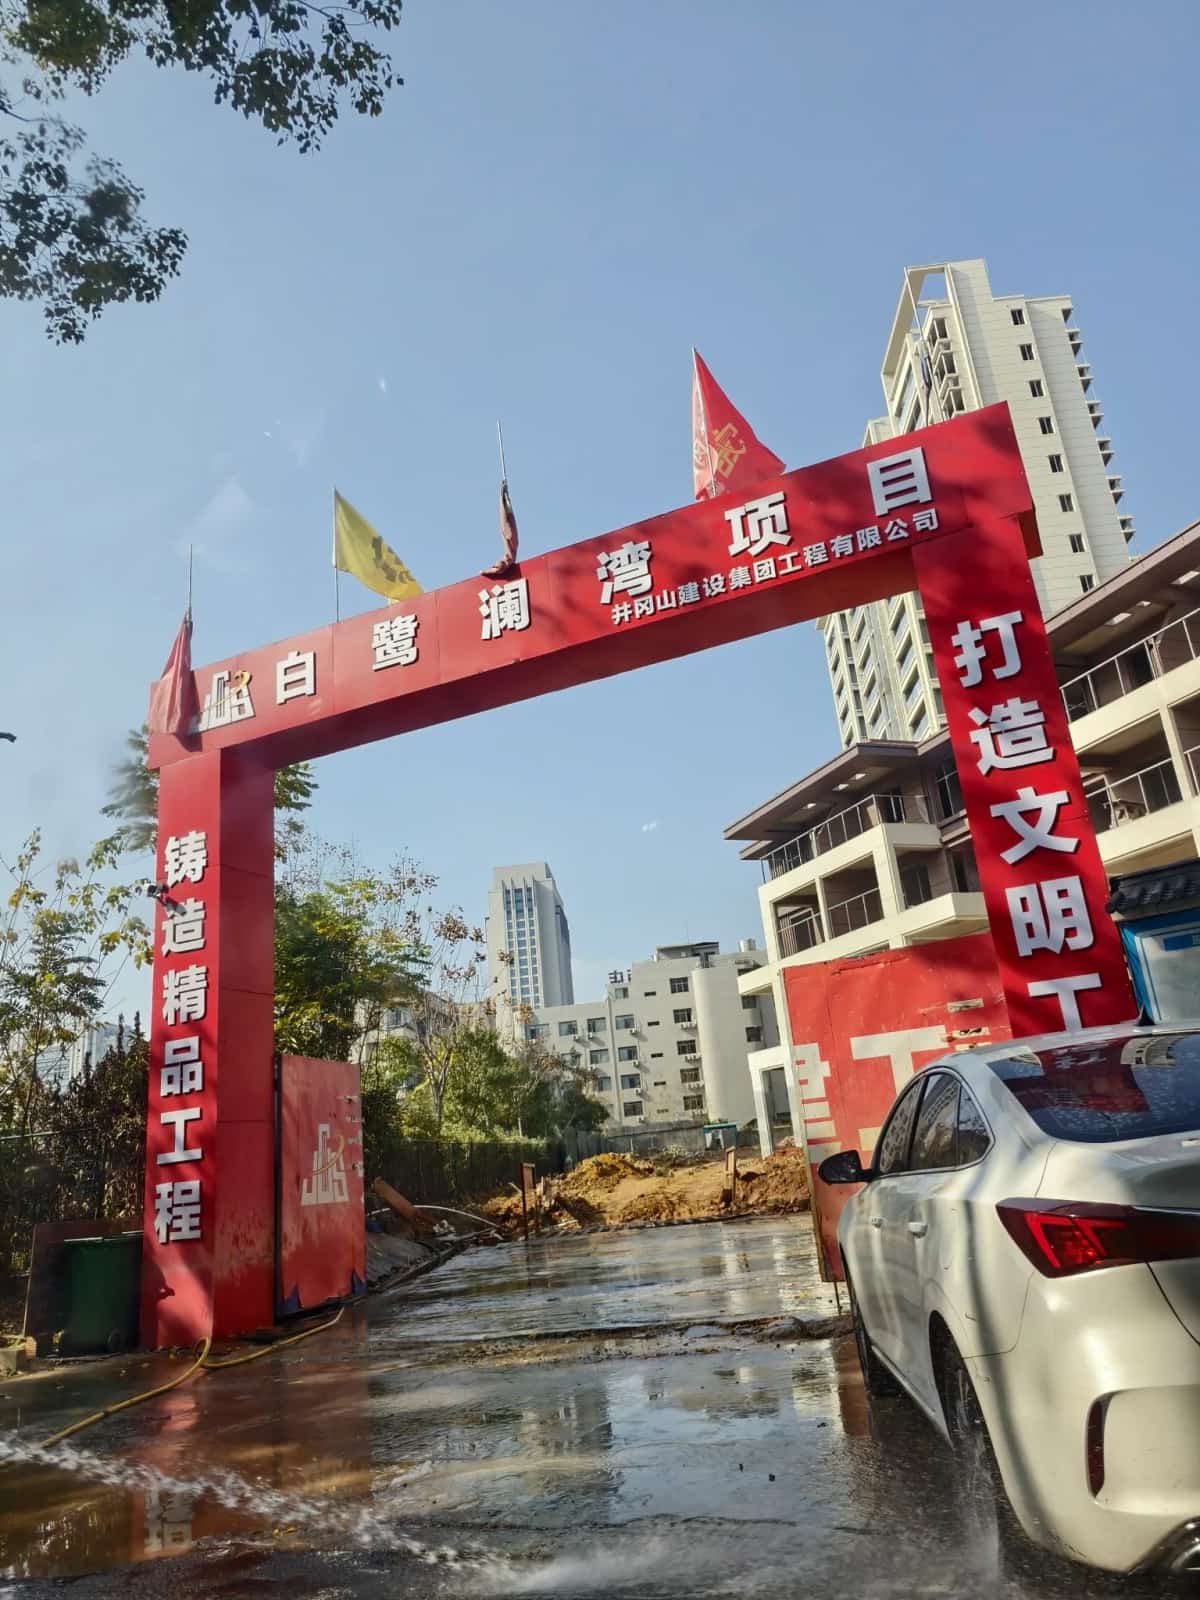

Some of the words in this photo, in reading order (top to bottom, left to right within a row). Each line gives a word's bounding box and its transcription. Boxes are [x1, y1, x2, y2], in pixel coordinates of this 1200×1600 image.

[276, 446, 934, 705] 白鹭澜湾项目
[611, 508, 939, 625] 井冈山建设集团工程有限公司
[154, 830, 208, 1244] 铸造精品工程
